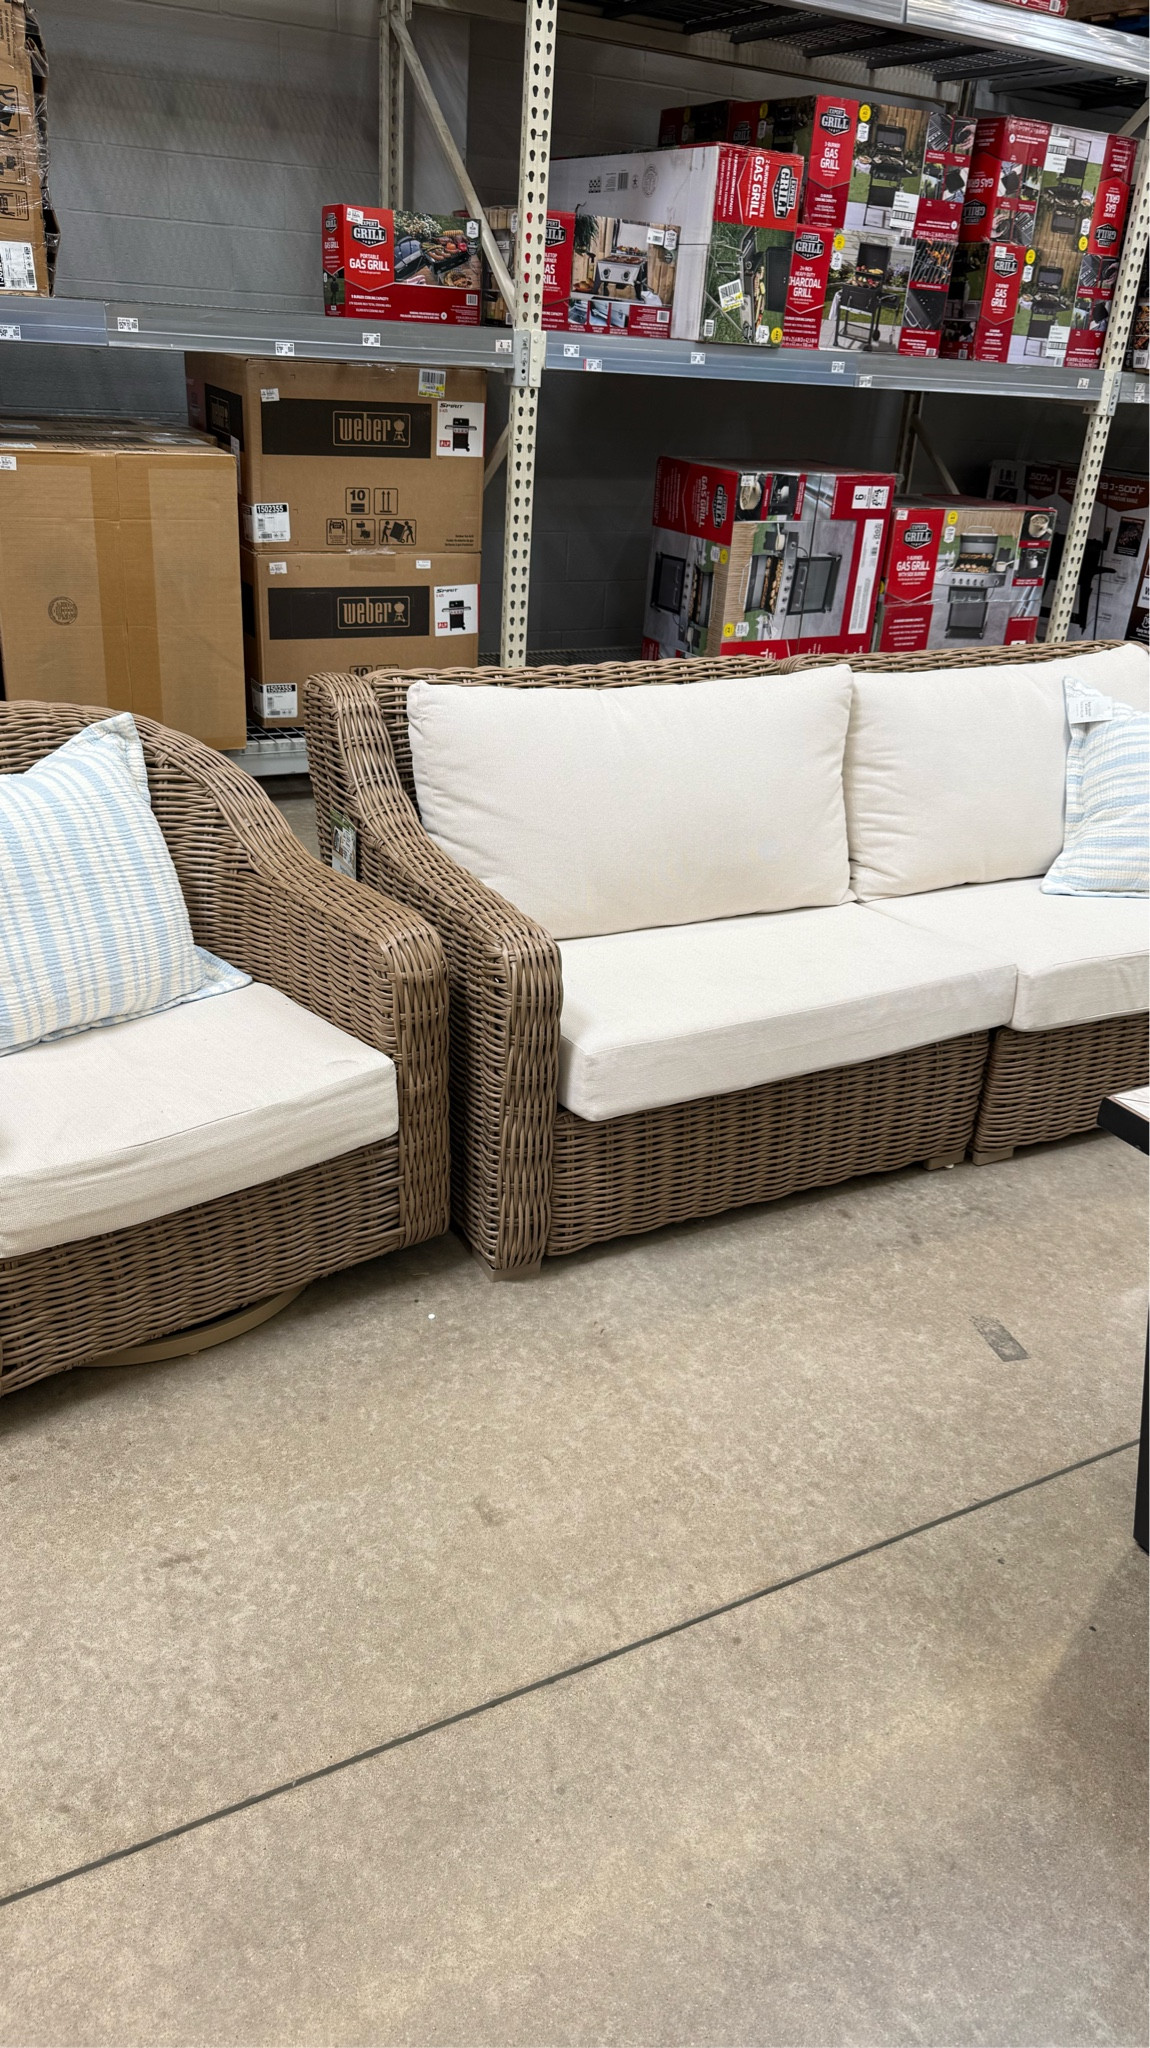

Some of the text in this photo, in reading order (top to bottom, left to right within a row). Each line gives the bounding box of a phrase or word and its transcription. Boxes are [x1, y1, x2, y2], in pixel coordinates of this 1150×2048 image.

[822, 116, 849, 129] GRILL
[824, 148, 838, 159] GAS
[820, 158, 840, 170] GRILL
[748, 156, 765, 218] GAS GRILL
[776, 168, 791, 216] GRILL
[788, 178, 797, 208] EXPERT
[1106, 193, 1120, 204] GRILL
[759, 189, 767, 218] PORTABLE
[353, 227, 385, 241] GRILL
[1096, 229, 1117, 240] GRILL
[796, 241, 822, 254] GRILL
[350, 258, 390, 272] GAS GRILL
[545, 264, 555, 274] AS
[994, 260, 1018, 271] GRILL
[543, 274, 558, 285] RILL
[793, 287, 812, 298] GRILL
[995, 288, 1008, 298] GAS
[991, 298, 1008, 308] GRILL
[338, 412, 392, 442] weber
[350, 490, 365, 501] 10
[258, 505, 284, 513] 1502355
[698, 499, 706, 528] GRILL
[904, 532, 930, 542] GRILL
[896, 560, 930, 571] GAS GRILL
[342, 597, 392, 624] weber
[353, 667, 368, 677] 10
